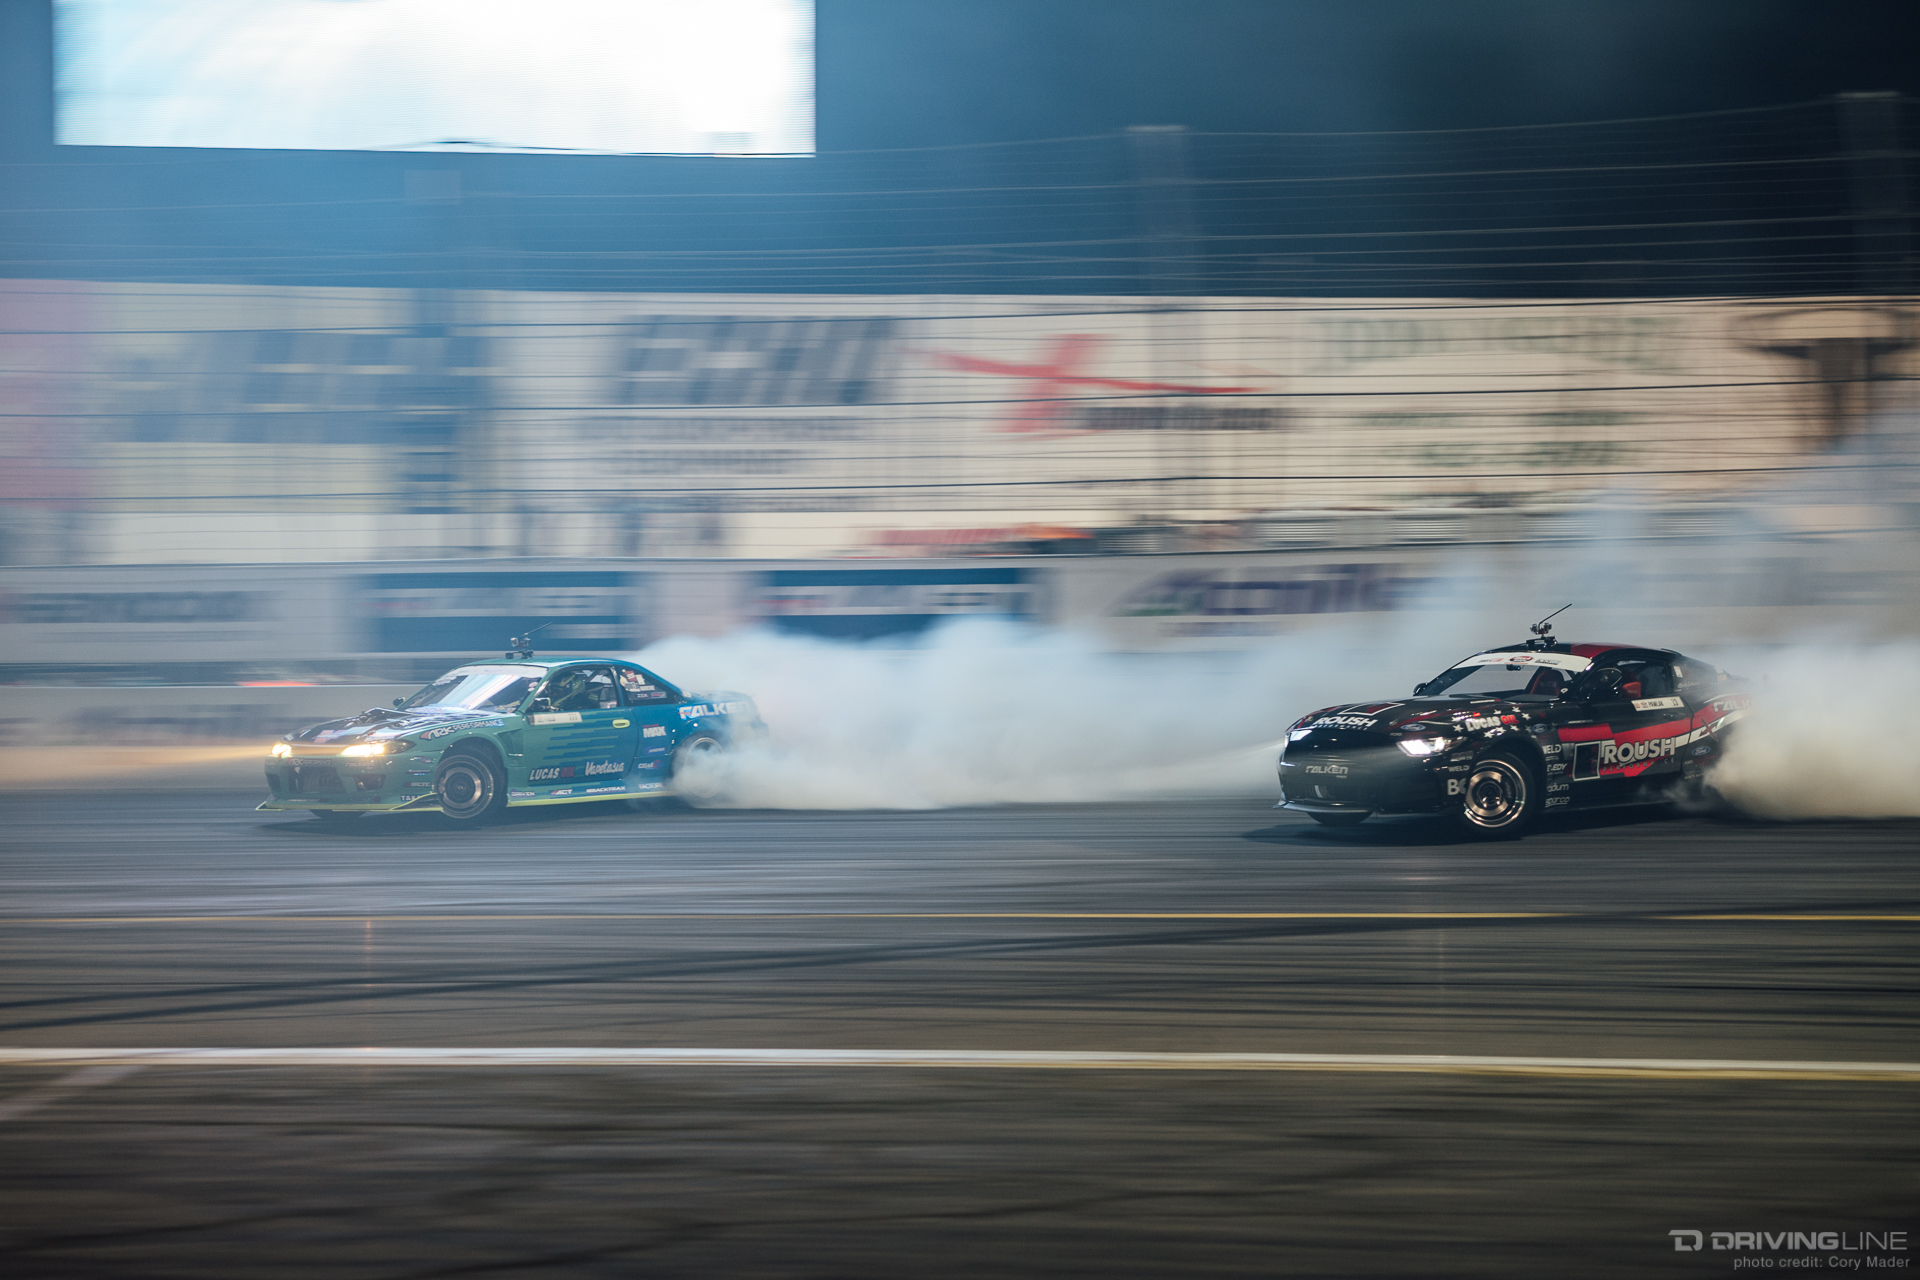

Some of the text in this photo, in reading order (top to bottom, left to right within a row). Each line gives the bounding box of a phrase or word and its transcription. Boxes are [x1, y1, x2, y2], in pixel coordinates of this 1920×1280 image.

[453, 719, 505, 731] PERFORMANCE
[1313, 716, 1379, 728] ROUSH
[1465, 714, 1519, 732] LUCAS OIL
[1603, 736, 1676, 765] ROUSH
[1305, 765, 1349, 775] FALKEN
[1602, 757, 1675, 773] PERFORMACE
[529, 767, 560, 781] LUCAS
